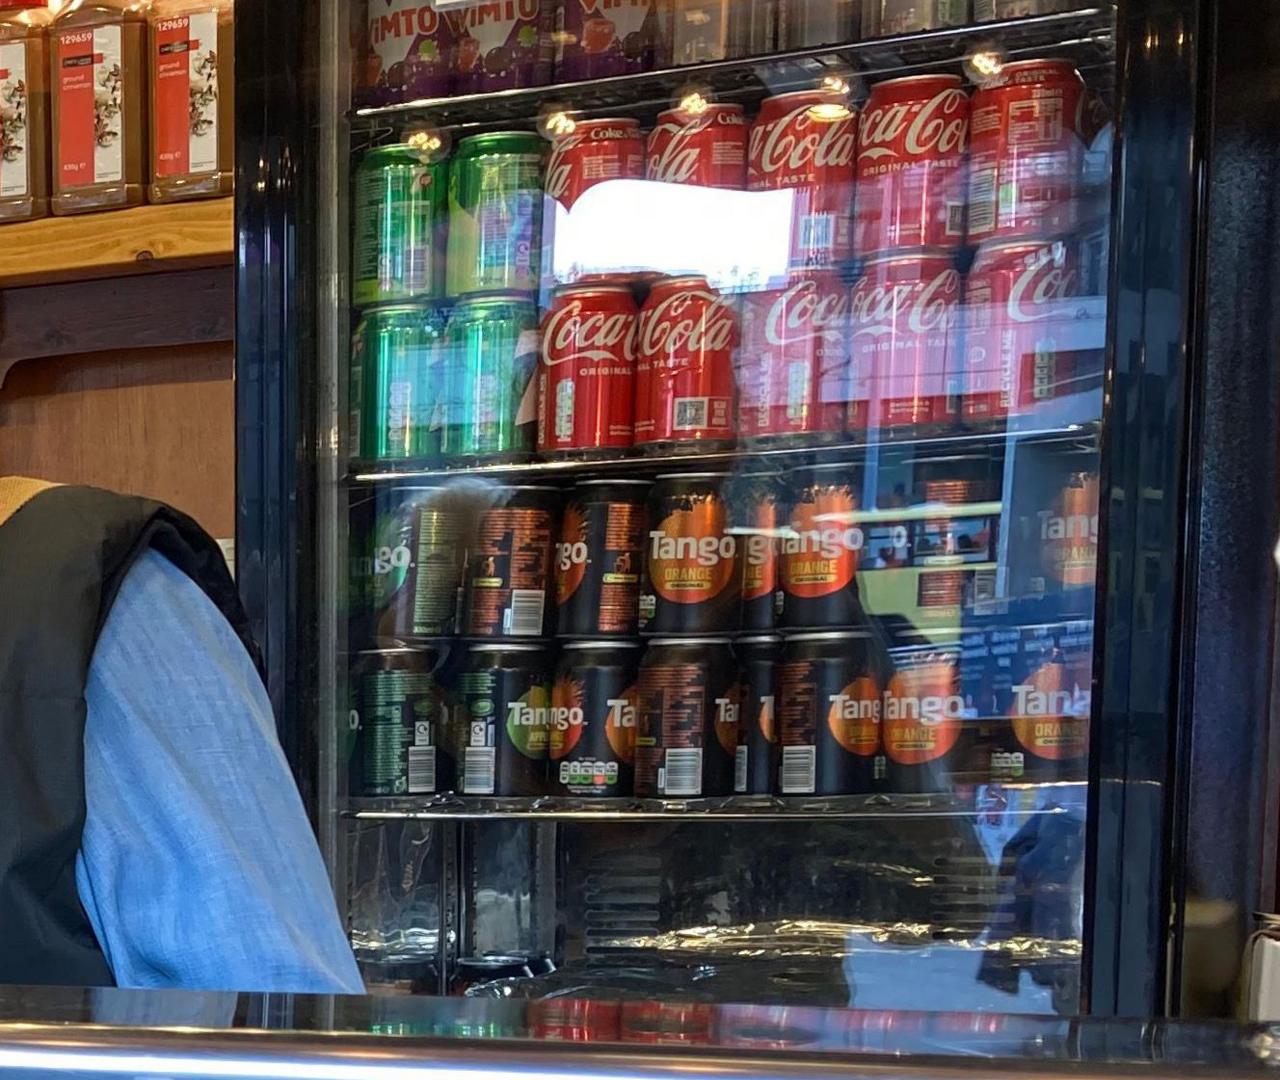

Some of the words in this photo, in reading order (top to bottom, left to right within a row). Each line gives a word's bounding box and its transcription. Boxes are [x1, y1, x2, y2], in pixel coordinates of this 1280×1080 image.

[157, 18, 188, 32] 129659
[60, 33, 92, 45] 129659
[863, 162, 918, 176] ORIGINAL
[776, 172, 816, 184] TASTE
[579, 367, 632, 376] ORIGINAL
[664, 567, 713, 580] ORANGE
